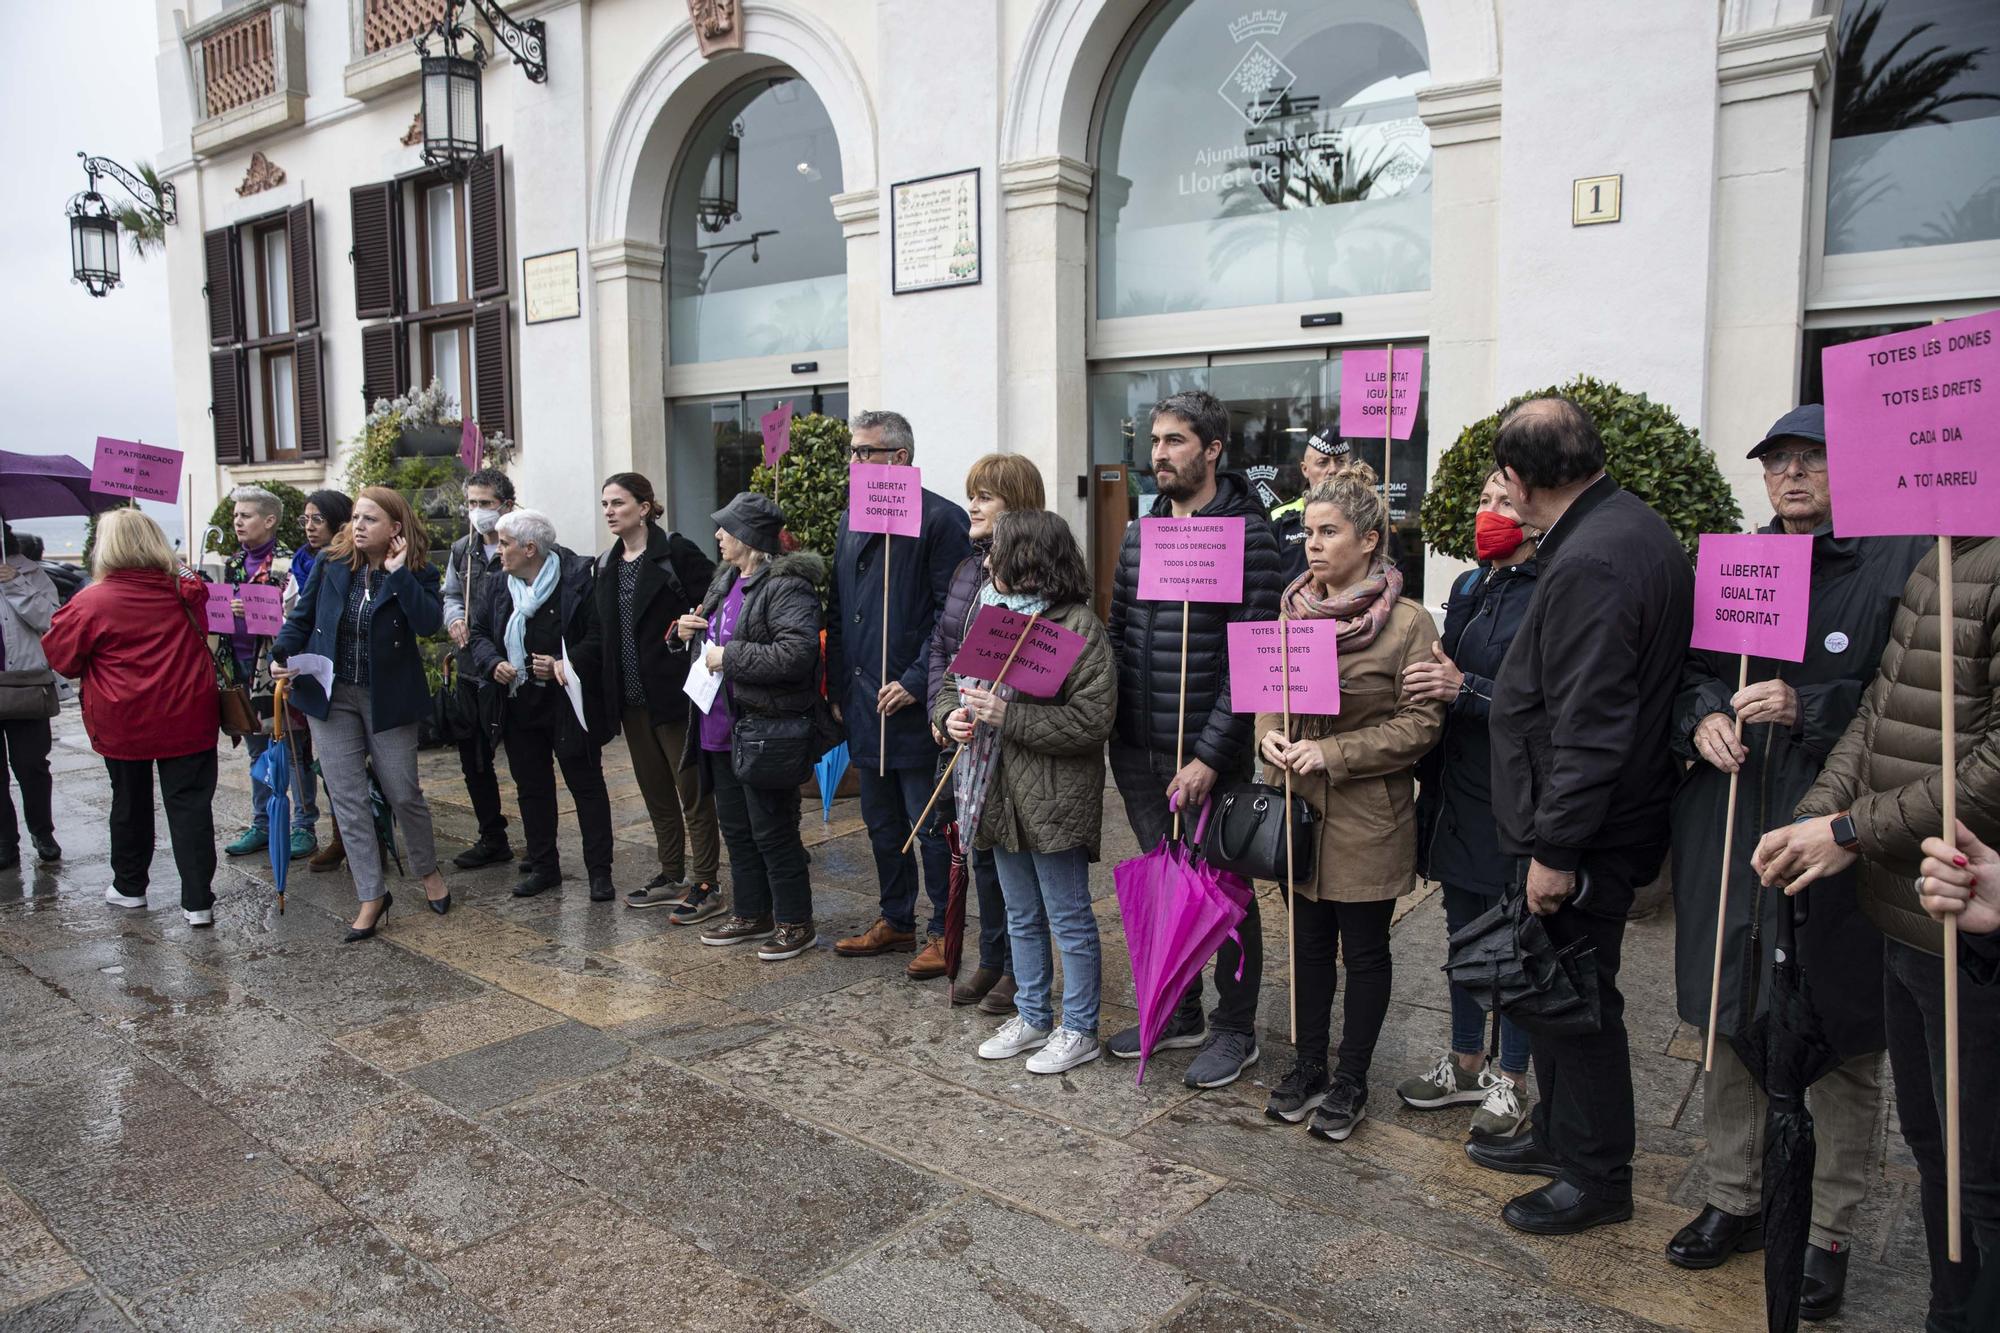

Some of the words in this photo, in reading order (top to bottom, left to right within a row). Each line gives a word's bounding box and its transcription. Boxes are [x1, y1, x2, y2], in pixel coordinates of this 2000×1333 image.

[1195, 136, 1295, 167] Ajuntament
[1297, 132, 1319, 149] de
[1178, 170, 1243, 196] Lloret
[1251, 161, 1281, 185] de
[1290, 156, 1340, 178] Mar
[1590, 184, 1603, 214] 1
[1868, 346, 1917, 367] TOTES
[1922, 340, 1941, 357] LES
[1948, 330, 1991, 352] DONES
[1365, 372, 1409, 382] LLIBRTAT
[1882, 389, 1919, 406] TOTS
[1922, 385, 1939, 401] ELS
[1942, 378, 1982, 398] DRETS
[1909, 429, 1936, 445] CADA
[1942, 427, 1963, 442] DIA
[118, 449, 174, 465] PATRIARCADO
[139, 469, 150, 477] DA
[1897, 475, 1908, 489] A
[1914, 473, 1933, 487] TOT
[1936, 471, 1978, 486] ARREU
[867, 481, 907, 491] LLIBERTAT
[868, 494, 906, 504] IGUALTAT
[865, 506, 908, 518] SORORITAT
[1192, 525, 1224, 533] MUJERES
[1720, 563, 1780, 579] LLIBERTAT
[1721, 586, 1776, 602] IGUALTAT
[1715, 608, 1780, 626] SORORITAT
[1001, 615, 1014, 625] LA
[1022, 620, 1059, 640] NSTRA
[1278, 627, 1290, 635] LS
[1292, 626, 1314, 634] DONES
[1028, 638, 1057, 655] ARMA
[1257, 646, 1275, 654] TOTS
[1269, 665, 1285, 673] CAD
[1290, 665, 1301, 673] DIA
